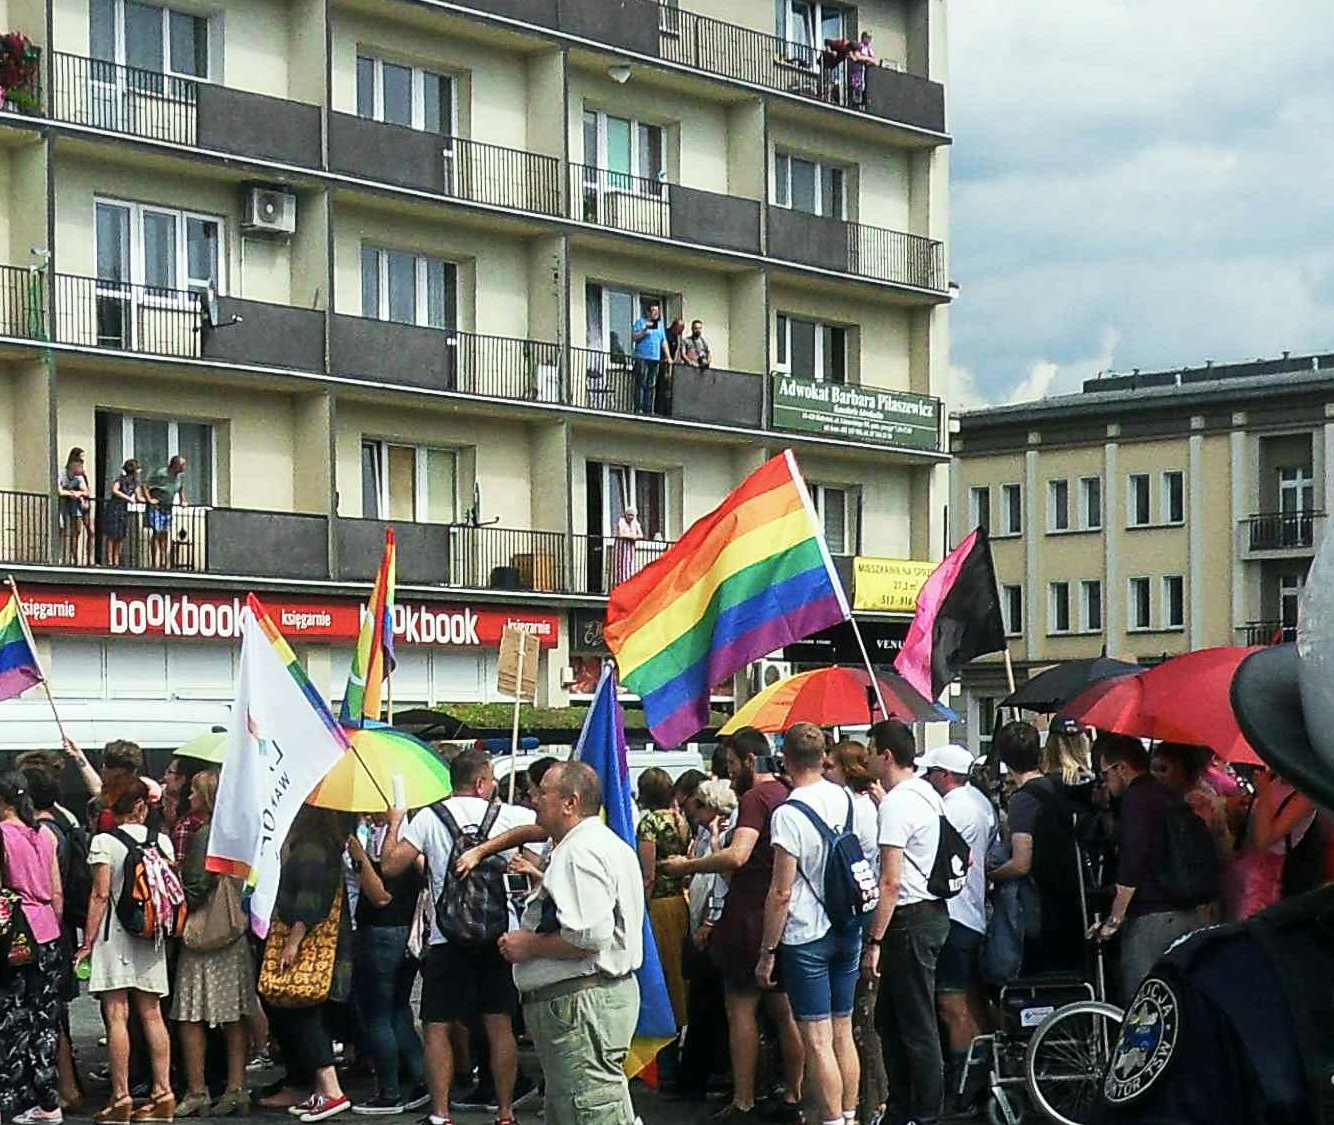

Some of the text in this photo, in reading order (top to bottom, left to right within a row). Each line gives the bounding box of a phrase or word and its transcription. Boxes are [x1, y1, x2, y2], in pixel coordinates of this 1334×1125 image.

[779, 378, 829, 402] Adwokat
[832, 387, 875, 409] Barbara
[110, 592, 246, 637] bookbook
[281, 609, 331, 630] księgarnie
[359, 603, 480, 645] okbook
